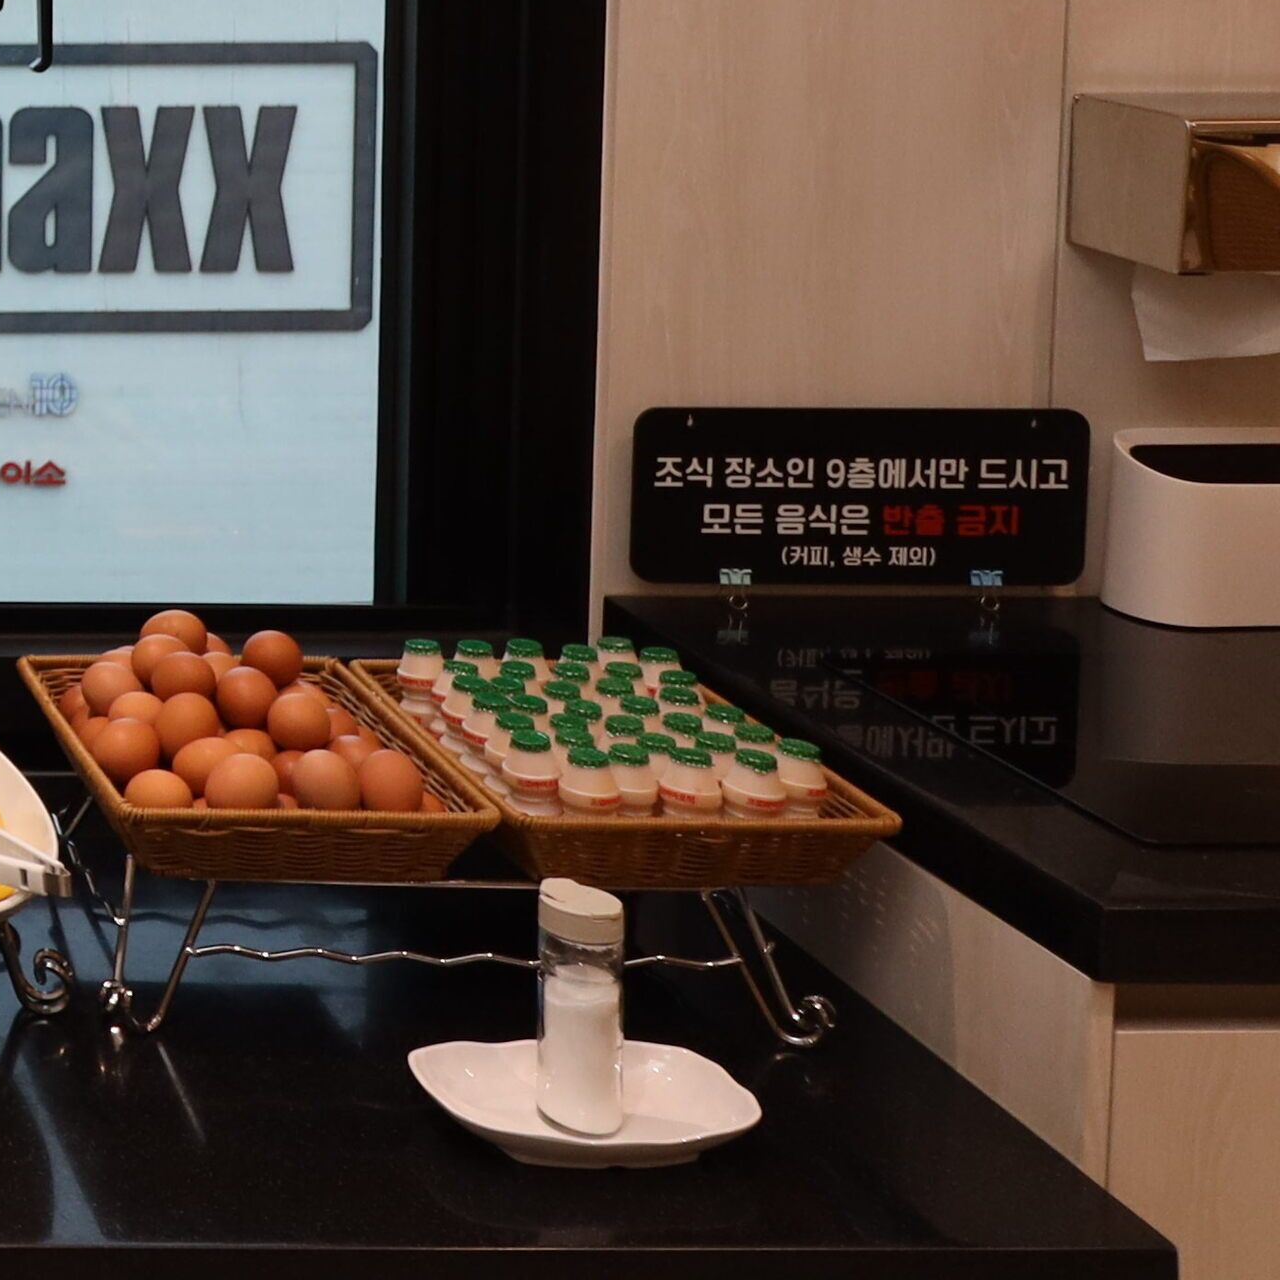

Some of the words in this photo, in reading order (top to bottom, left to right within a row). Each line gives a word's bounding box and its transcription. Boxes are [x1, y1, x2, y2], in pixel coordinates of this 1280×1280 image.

[654, 457, 713, 487] 조식
[725, 458, 814, 488] 장소인
[827, 458, 969, 488] 9층에서만
[978, 459, 1068, 489] 드시고
[701, 504, 763, 534] 모든
[776, 505, 870, 535] 음식은
[884, 505, 944, 535] 반출
[958, 505, 1019, 536] 금지
[782, 546, 834, 567] (커피,
[843, 547, 881, 565] 생수
[889, 547, 935, 566] 제외)
